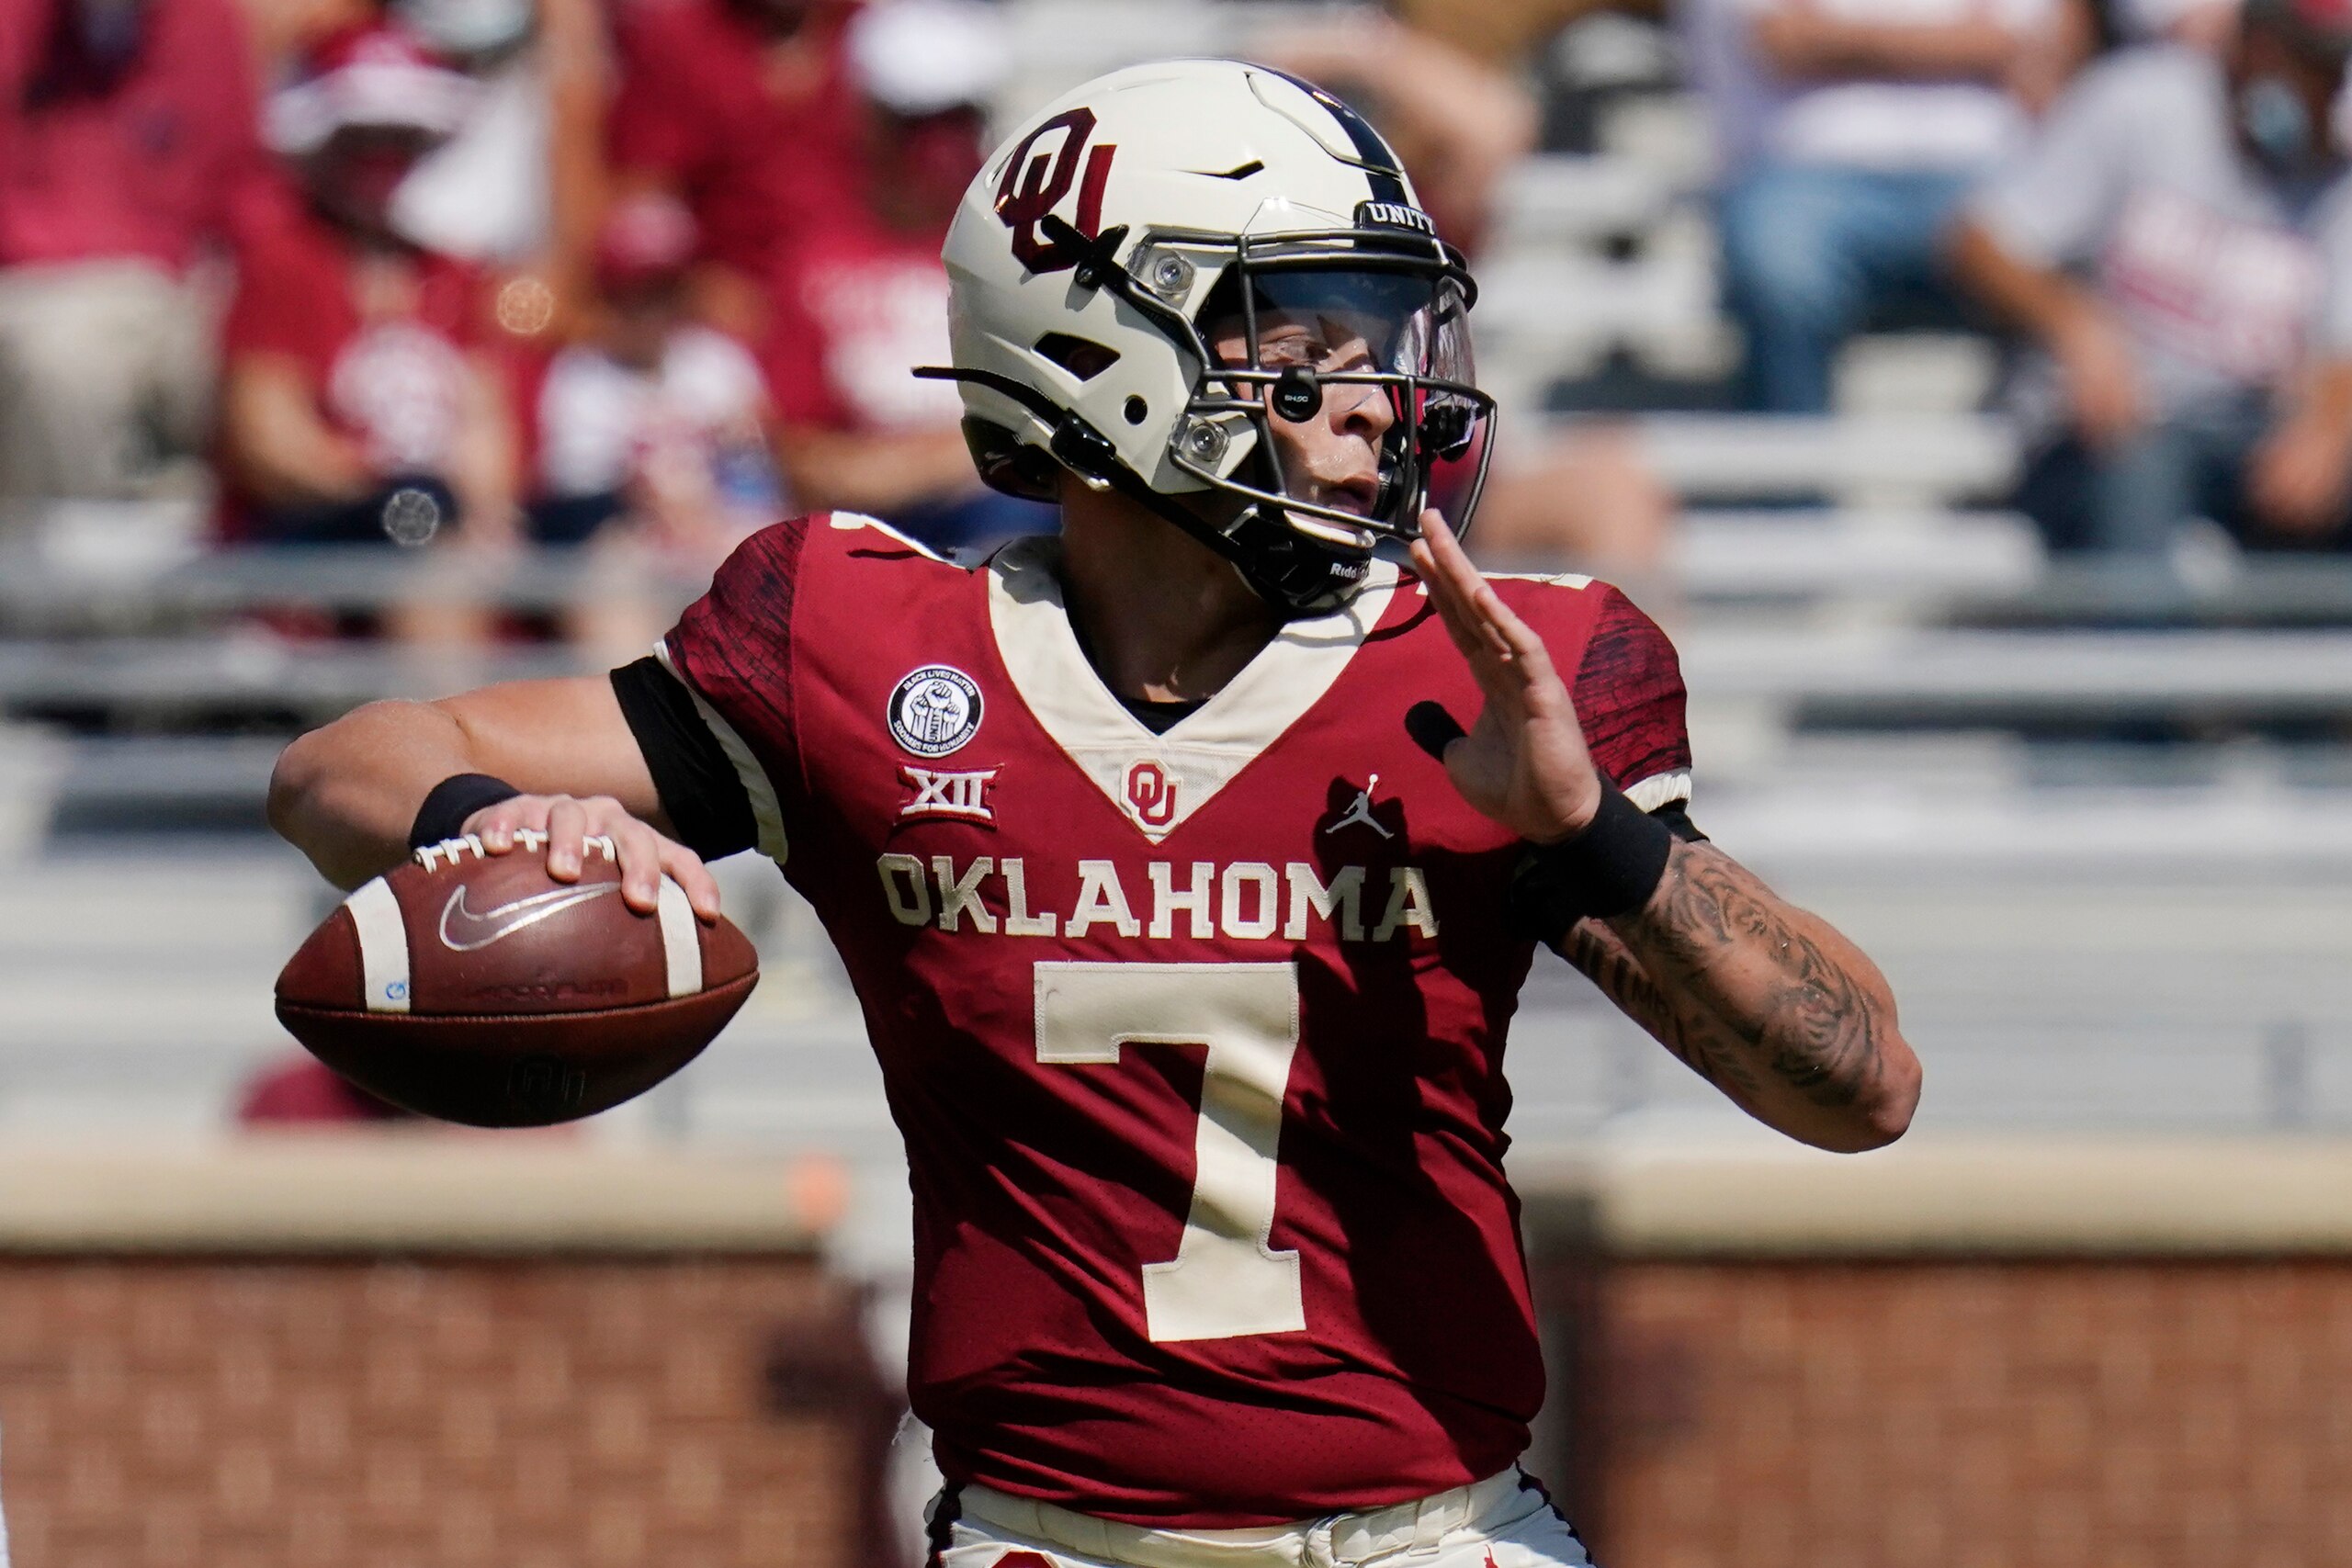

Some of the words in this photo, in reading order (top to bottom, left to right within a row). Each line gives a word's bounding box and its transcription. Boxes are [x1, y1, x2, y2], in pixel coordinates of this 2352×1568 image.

[993, 107, 1117, 275] OU
[1365, 202, 1435, 236] UNITY
[902, 671, 928, 692] BLACK
[927, 669, 952, 680] LIVES
[950, 672, 977, 697] MATTER
[922, 743, 940, 753] FOR
[901, 765, 997, 820] XII
[1127, 762, 1177, 827] OU
[876, 852, 1441, 942] OKLAHOMA
[1034, 961, 1306, 1343] 7
